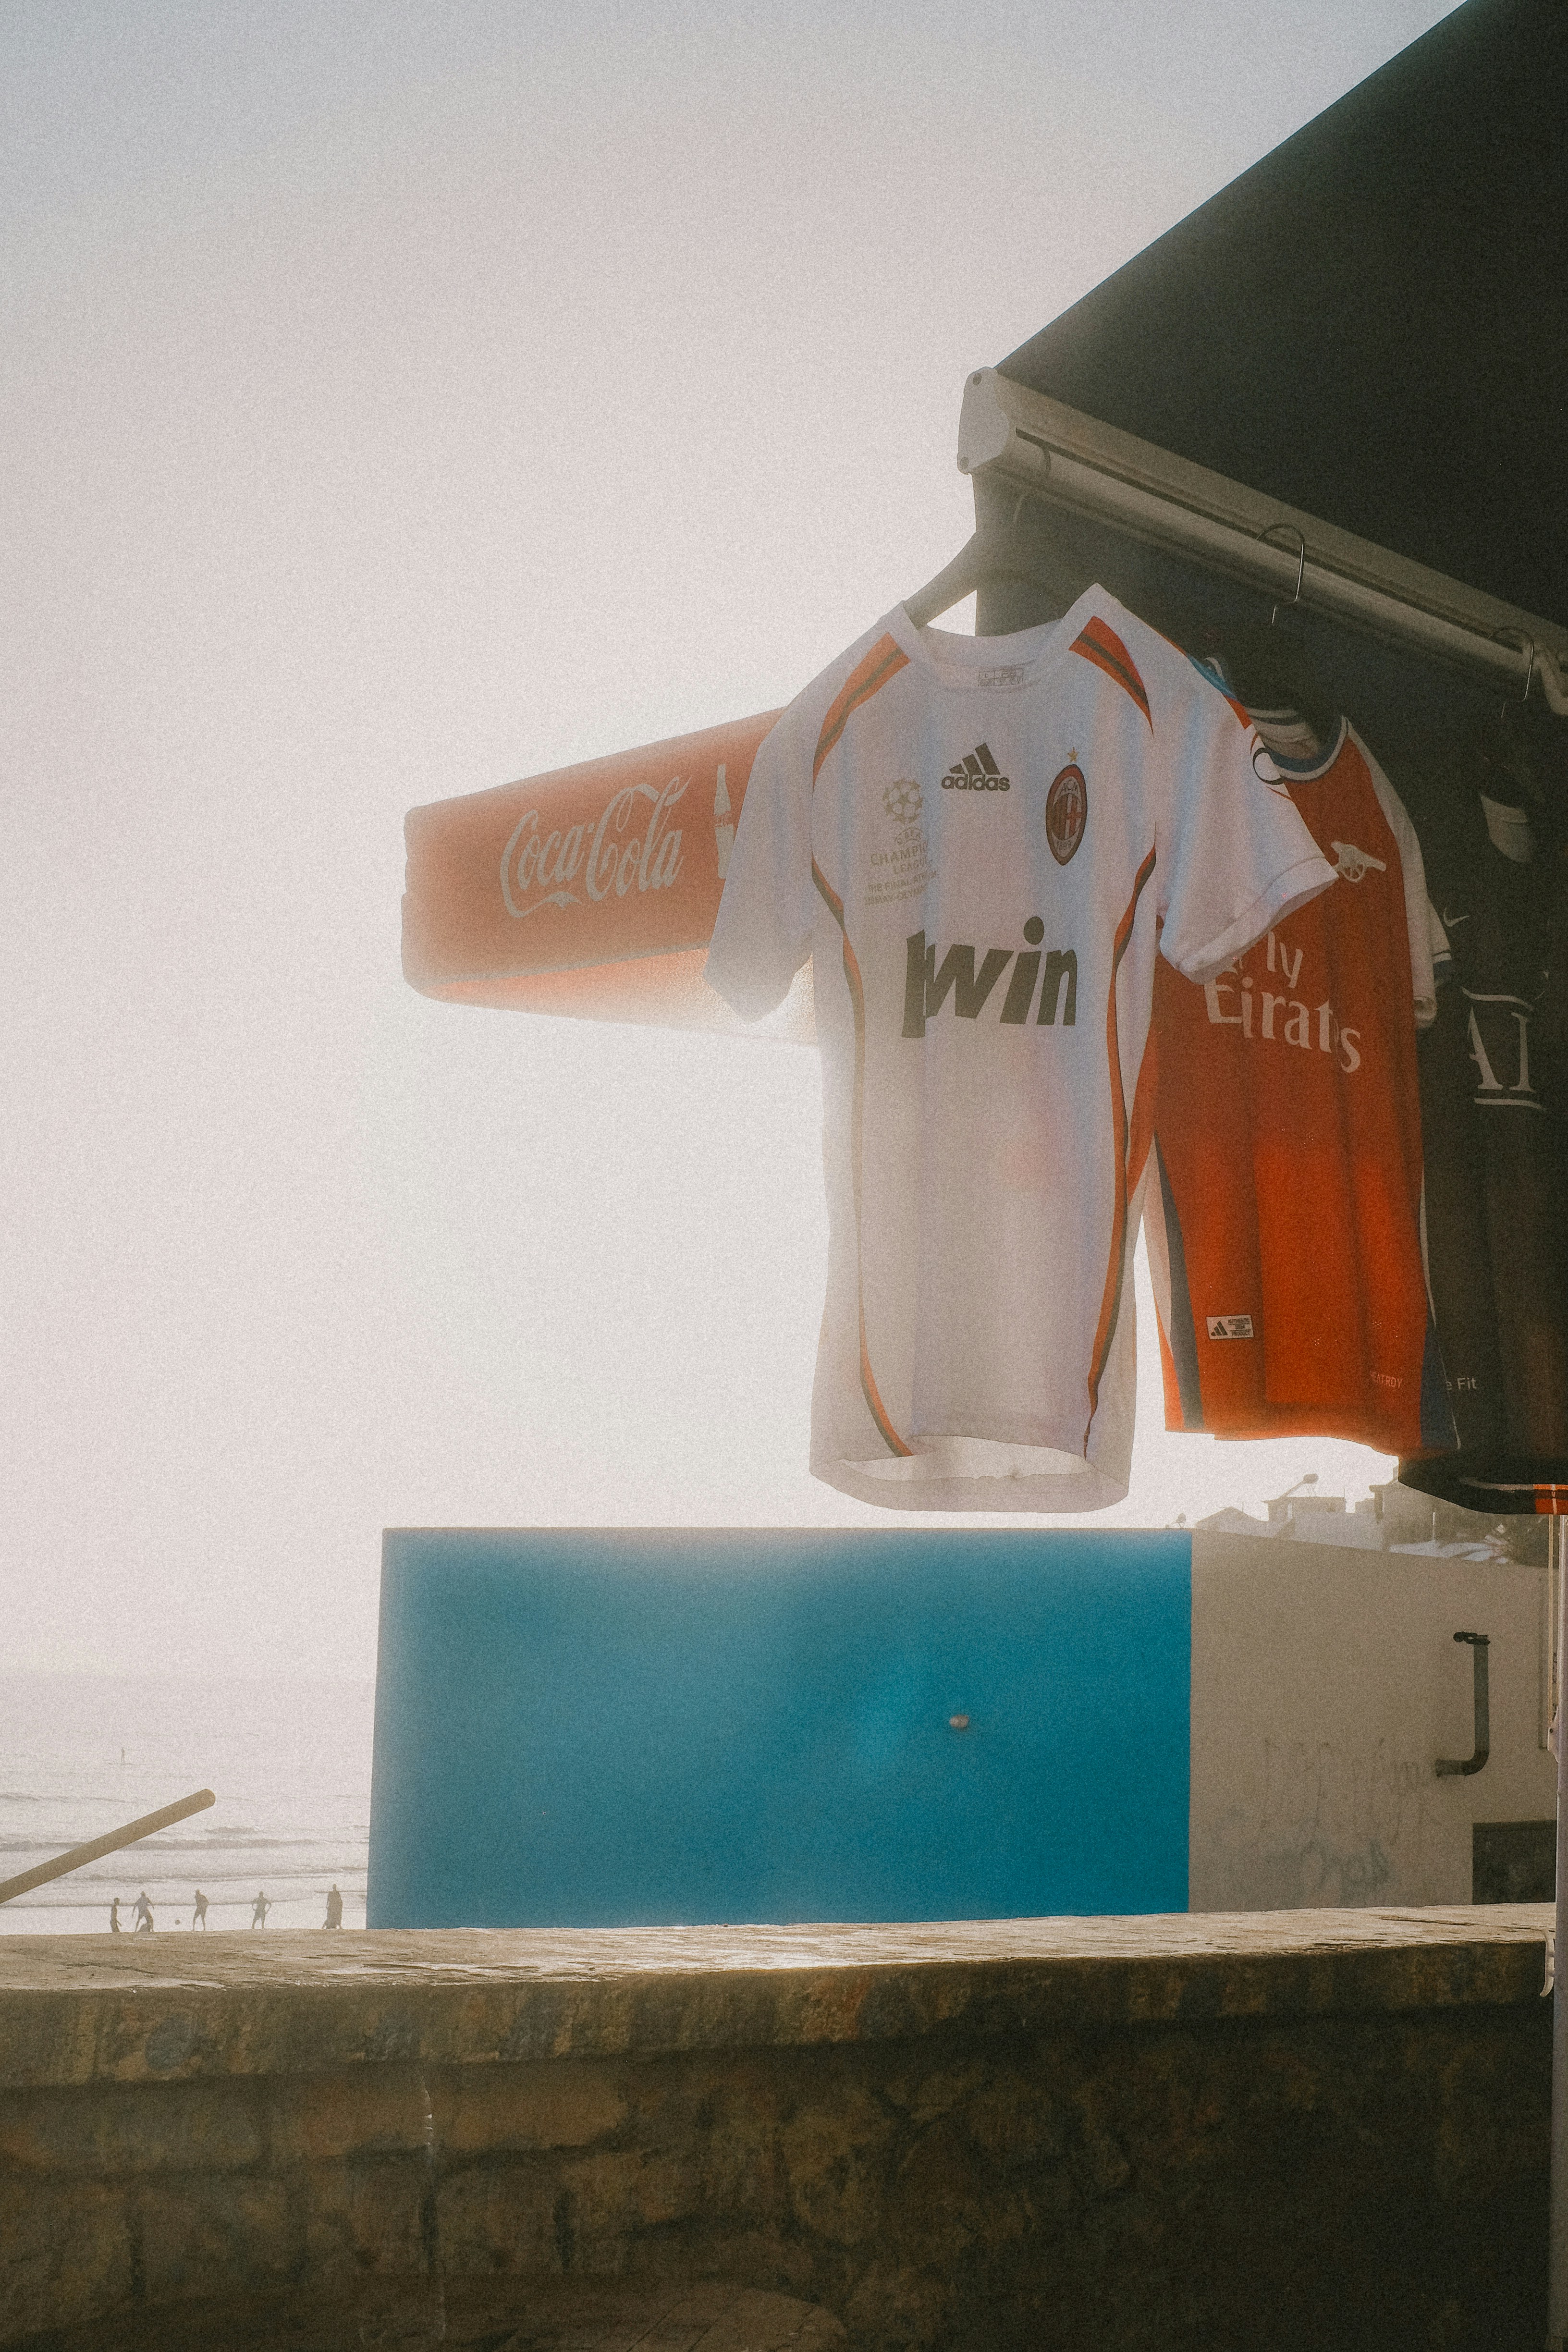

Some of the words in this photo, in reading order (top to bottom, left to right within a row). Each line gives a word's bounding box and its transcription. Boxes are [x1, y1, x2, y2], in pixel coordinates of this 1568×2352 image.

[941, 773, 1011, 791] adidas
[500, 775, 691, 918] Coca-Cola
[1457, 1377, 1477, 1390] Fit
